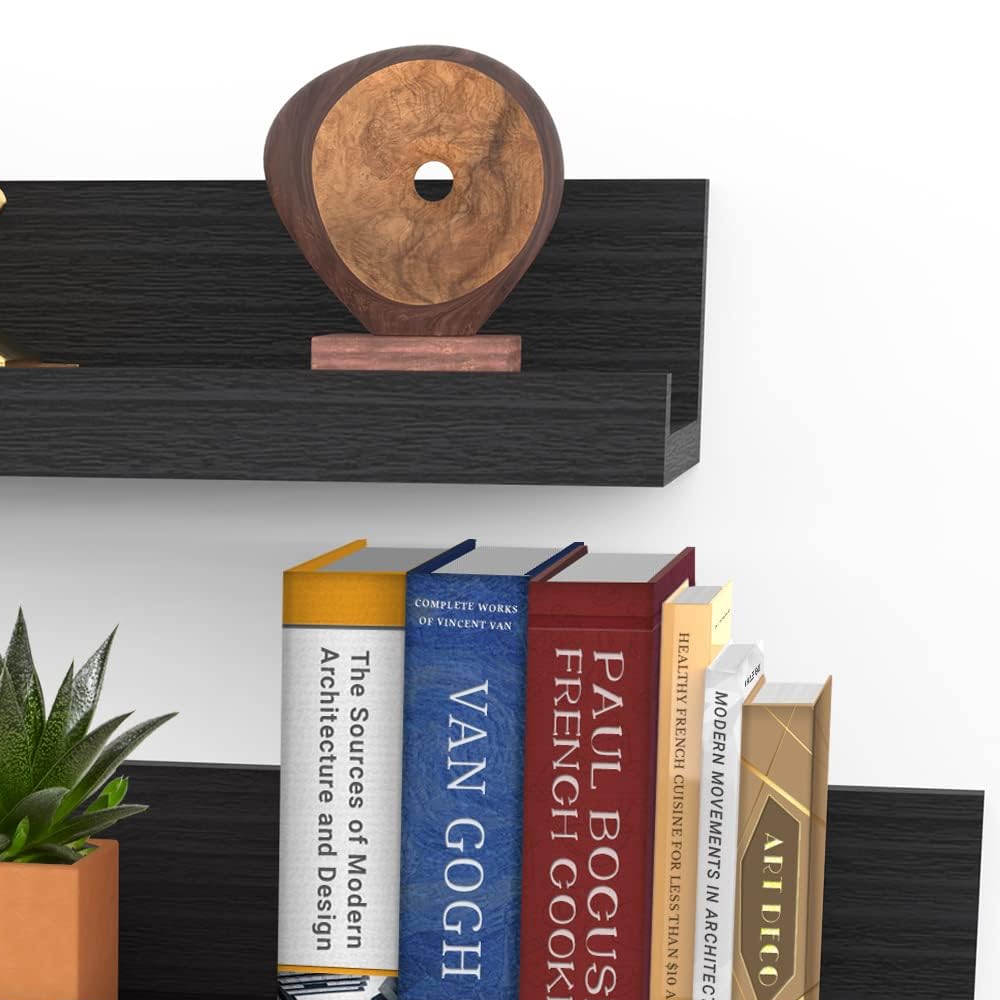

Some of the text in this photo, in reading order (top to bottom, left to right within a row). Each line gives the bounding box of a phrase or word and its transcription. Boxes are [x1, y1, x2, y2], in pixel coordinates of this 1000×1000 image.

[414, 598, 518, 614] COMPLETE WORKS
[419, 616, 512, 631] OF VINCENT VAN
[676, 632, 690, 704] HEALTHY
[550, 648, 583, 841] FRENCH
[589, 650, 625, 790] PAUL
[674, 708, 687, 770] FRENCH
[711, 691, 728, 765] MODERN
[312, 647, 340, 951] Architecture and Design
[346, 650, 370, 949] The Sources of Modern
[441, 680, 489, 980] VAN GOGH
[671, 774, 685, 837] CUISINE
[707, 770, 724, 880] MOVEMENTS
[670, 841, 682, 871] FOR
[669, 875, 681, 911] LESS
[705, 885, 719, 903] IN
[758, 832, 784, 987] ART DECO
[667, 914, 679, 959] THAN
[665, 962, 679, 986] $10
[665, 990, 676, 1000] A
